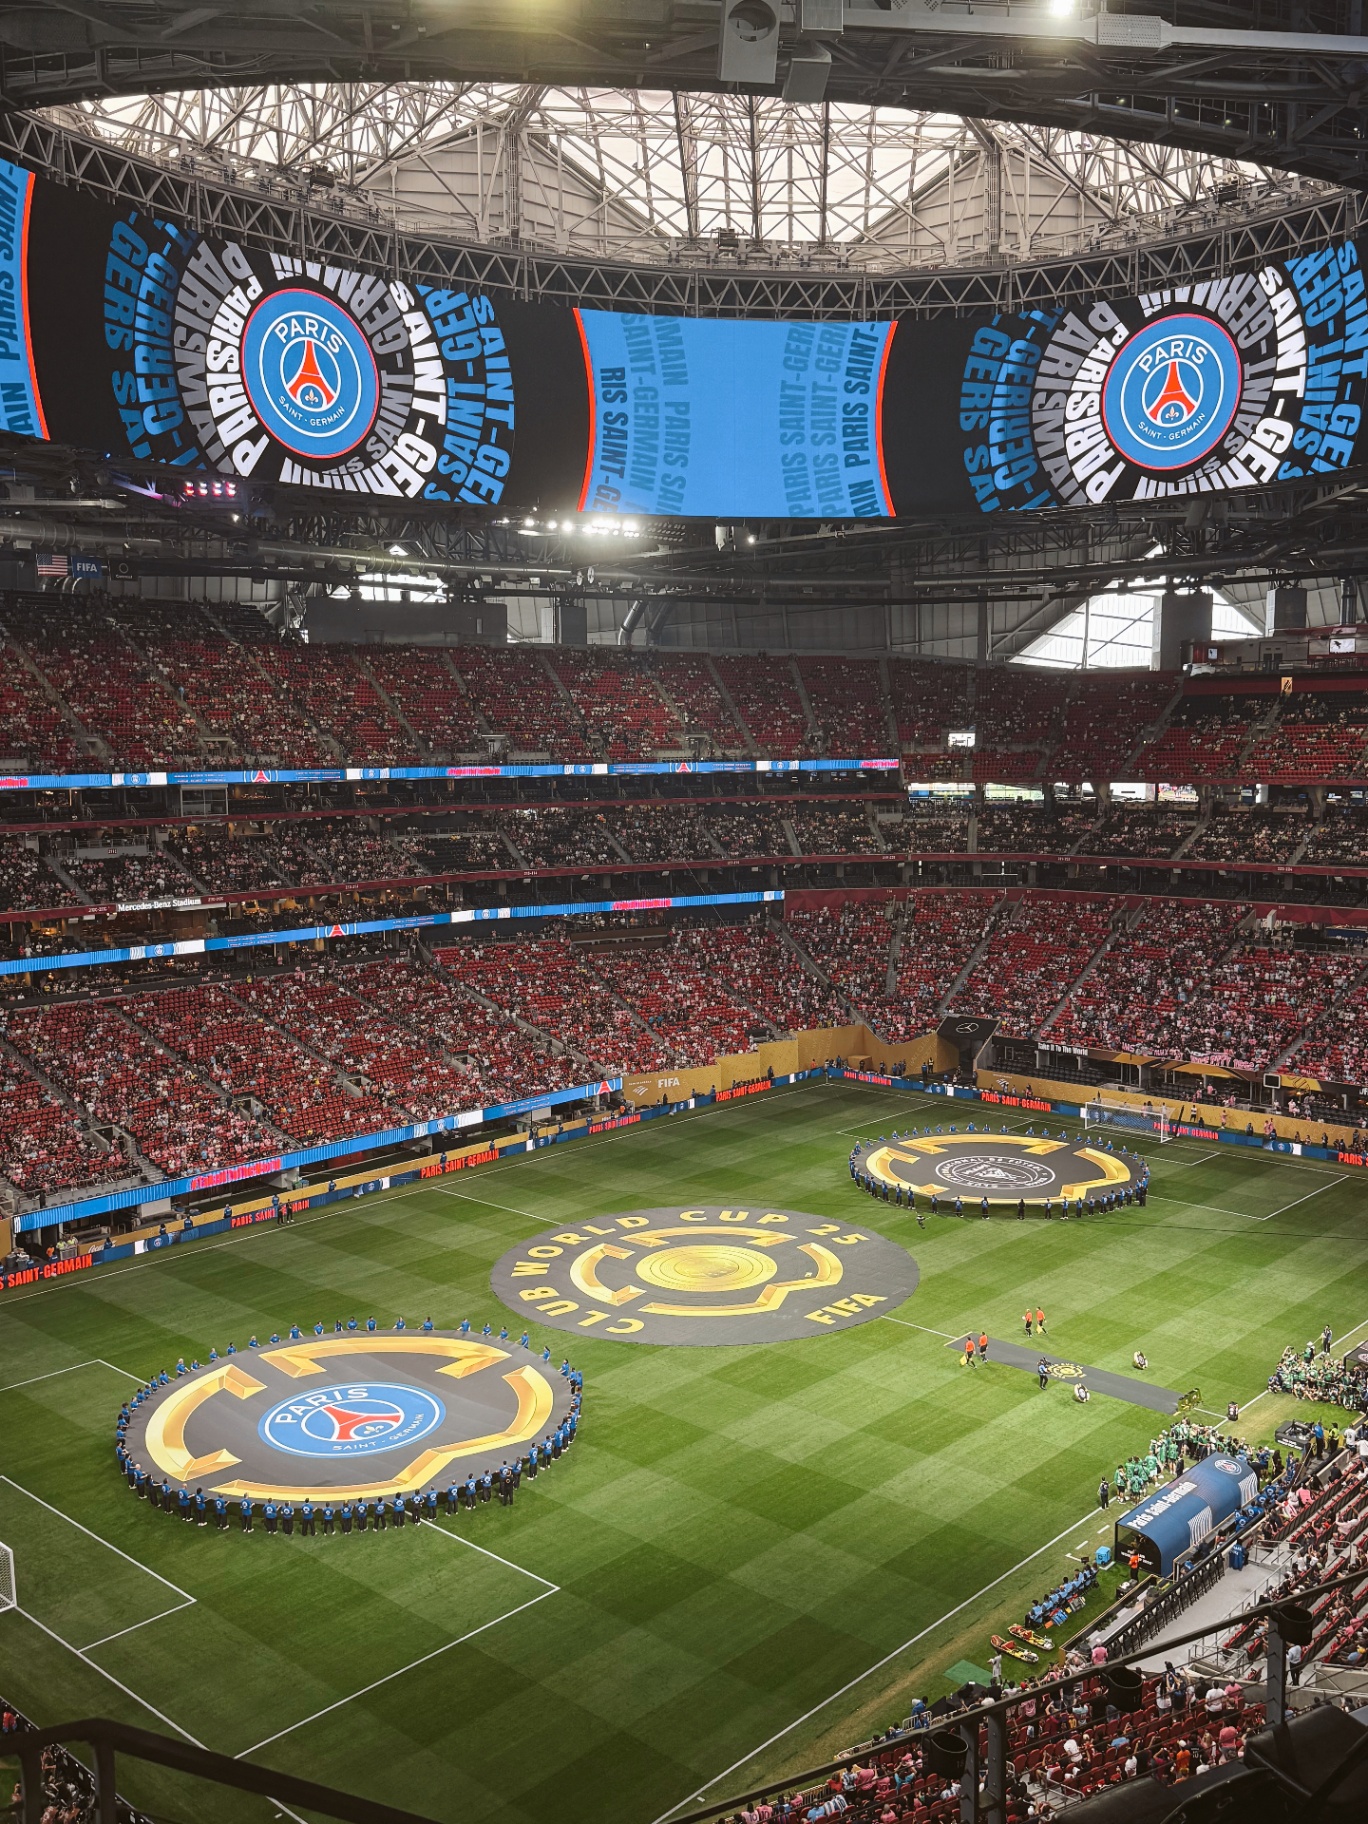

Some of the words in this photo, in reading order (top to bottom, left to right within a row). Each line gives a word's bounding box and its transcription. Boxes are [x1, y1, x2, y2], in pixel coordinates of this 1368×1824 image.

[274, 318, 343, 354] PARIS
[1138, 340, 1208, 373] PARIS
[279, 395, 303, 422] SAINT
[310, 405, 345, 427] GERMAIN
[664, 401, 691, 468] PARIS
[842, 402, 871, 468] PARIS
[1138, 421, 1162, 440] SAINT
[1168, 413, 1206, 441] GERMAIN
[76, 562, 98, 572] FIFA
[118, 900, 171, 912] Mercedes-Benz
[172, 899, 201, 907] Stadium
[657, 1077, 680, 1088] FIFA
[716, 1090, 731, 1103] PARIS
[981, 1092, 1000, 1103] PARIS
[420, 1163, 443, 1179] PARIS
[445, 1148, 499, 1173] SAINT-GERMAIN
[1338, 1151, 1363, 1166] PARIS
[231, 1216, 253, 1228] PARIS
[679, 1209, 790, 1225] CUP
[511, 1215, 651, 1277] WORLD
[804, 1224, 872, 1245] 25
[7, 1253, 93, 1288] SAINT-GERMAIN
[518, 1285, 645, 1334] CLUB
[803, 1291, 889, 1326] FIFA
[274, 1388, 369, 1424] PARIS
[332, 1441, 377, 1451] SAINT
[1127, 1513, 1154, 1529] Paris
[1145, 1481, 1198, 1516] Saint-Germain
